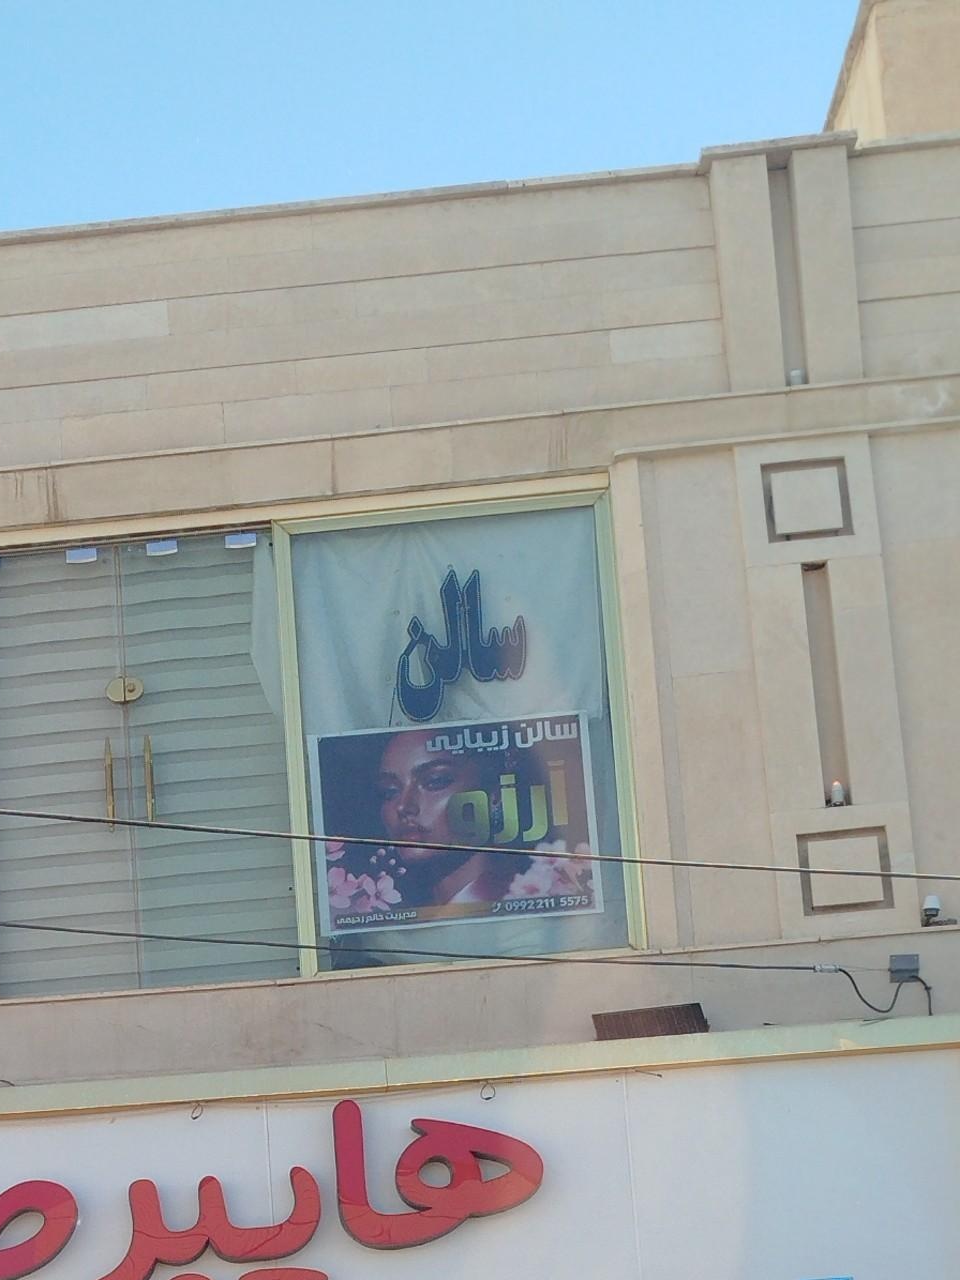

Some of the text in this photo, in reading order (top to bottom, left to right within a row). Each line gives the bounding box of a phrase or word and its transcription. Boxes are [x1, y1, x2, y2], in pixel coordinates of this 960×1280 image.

[397, 569, 527, 722] سالن
[425, 721, 578, 754] سالن زیبایی
[447, 760, 569, 844] آرزو
[385, 911, 417, 921] مدیریت
